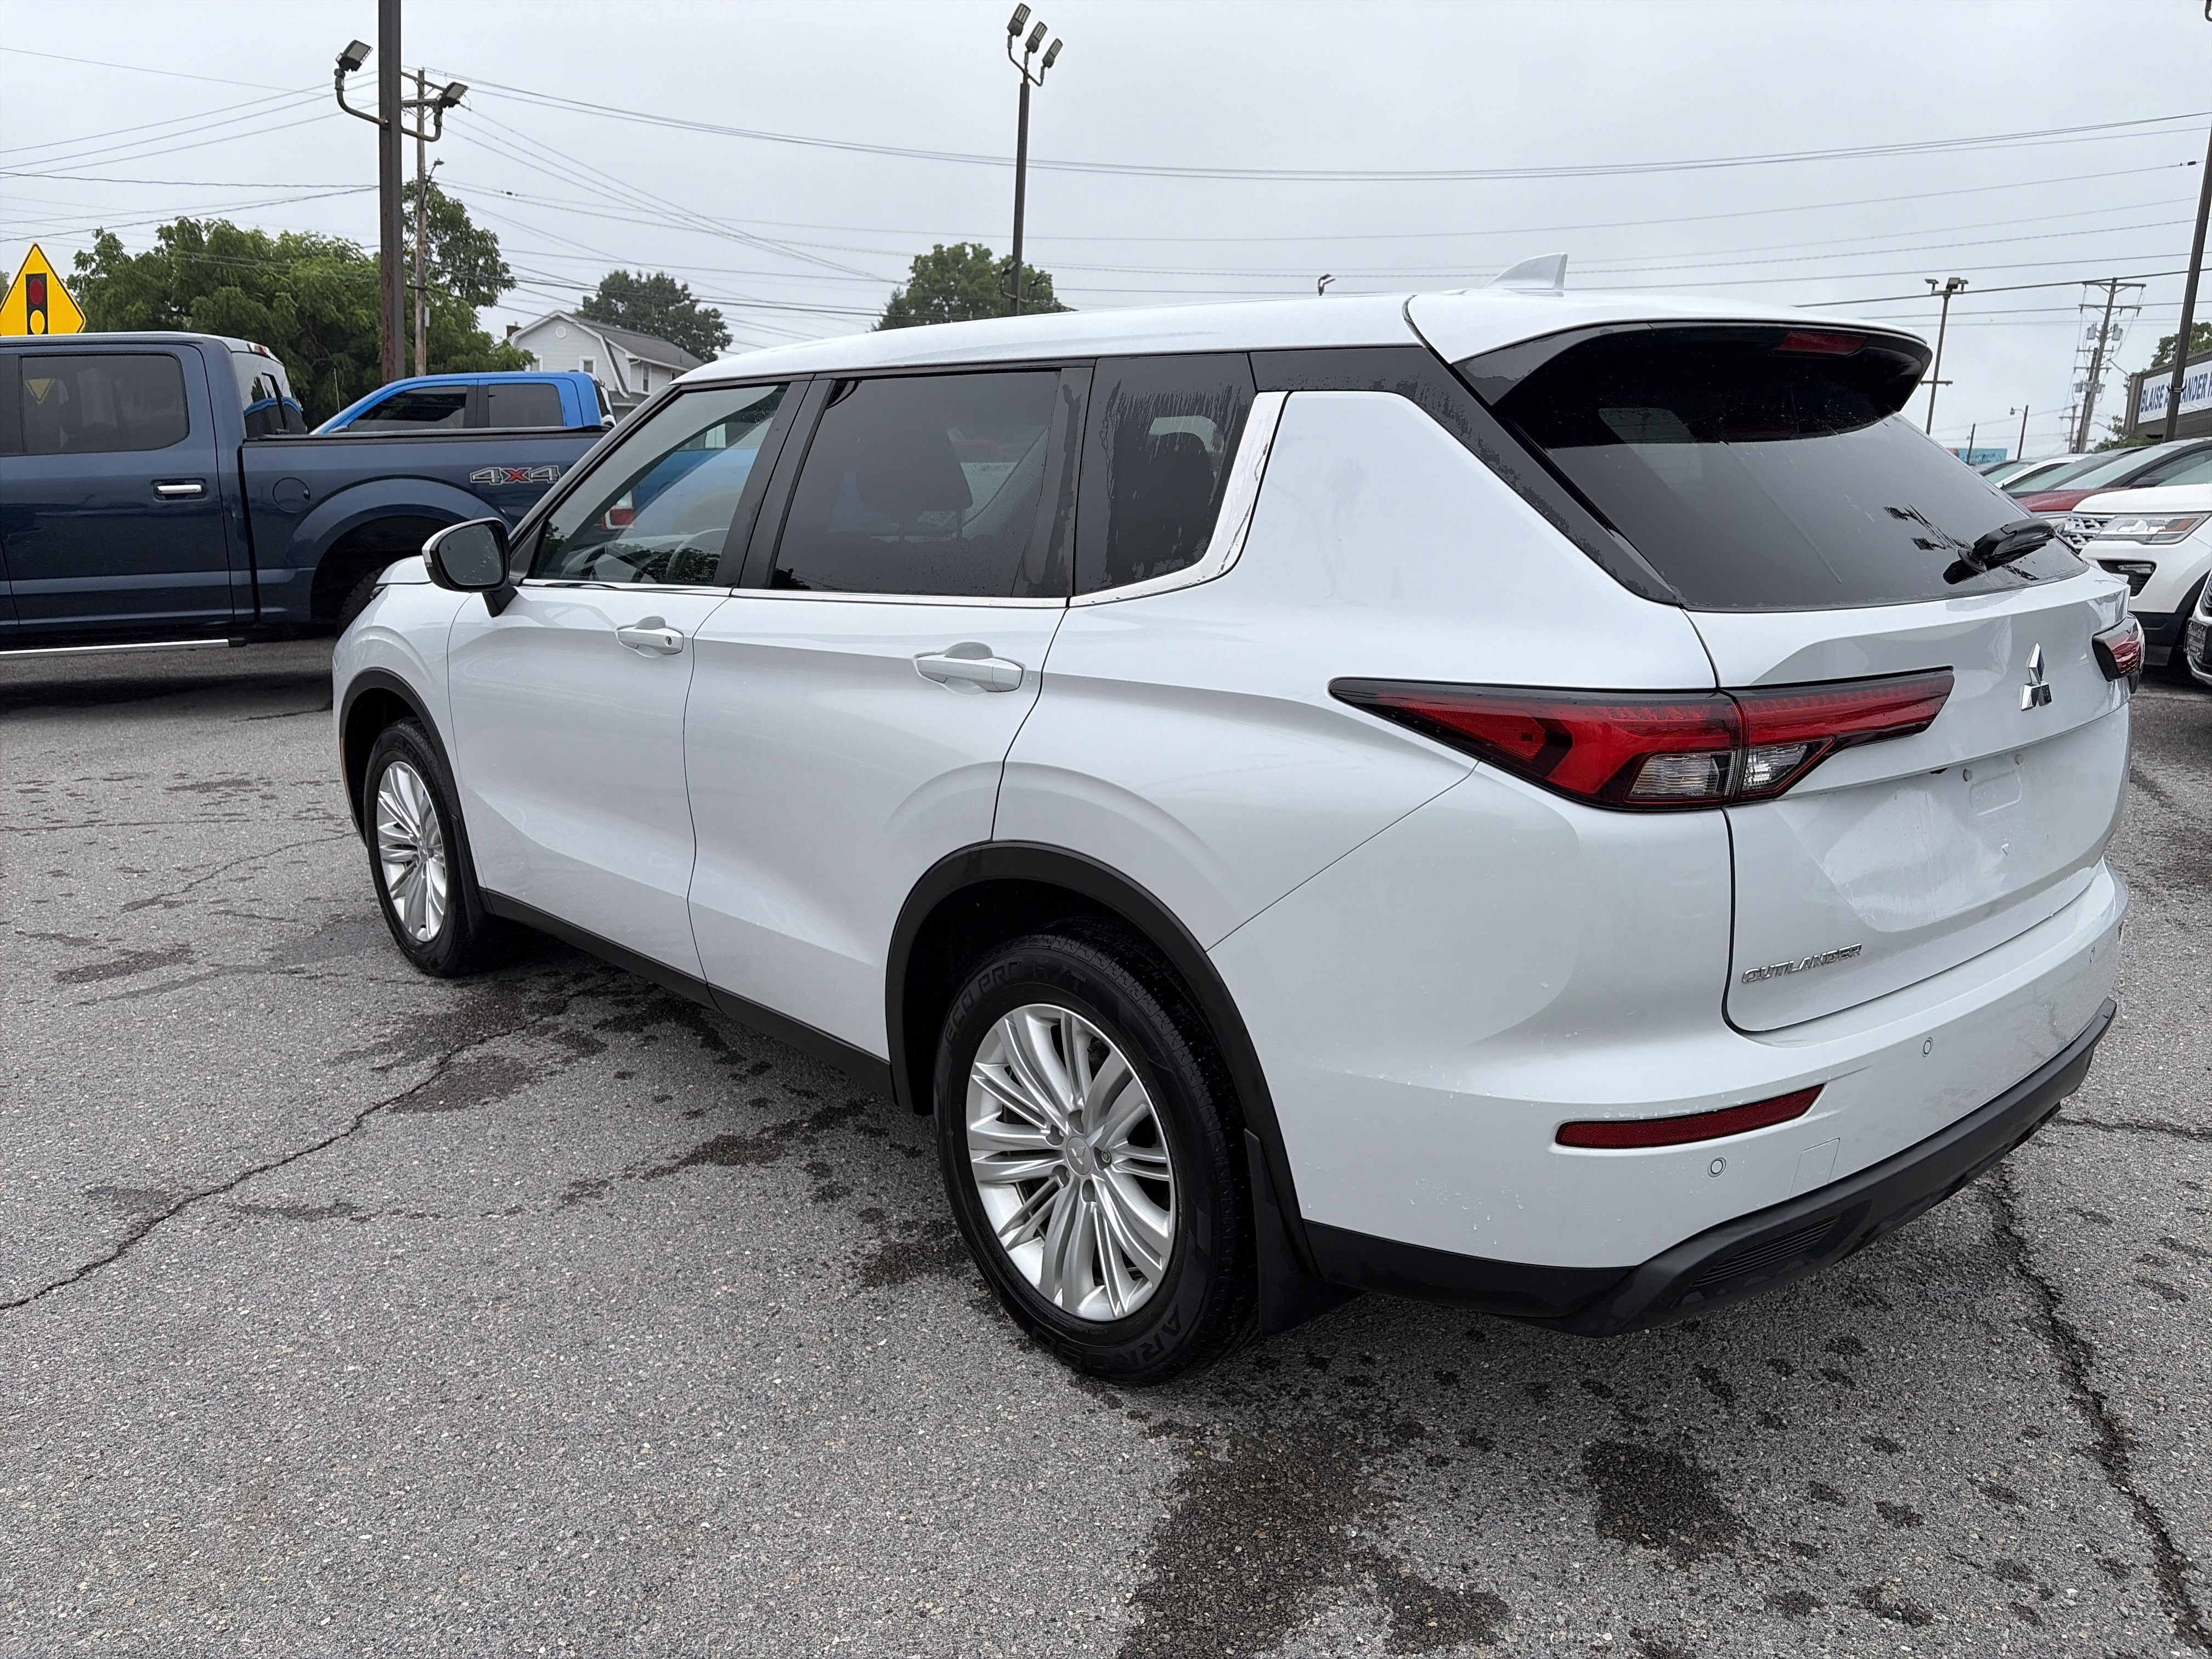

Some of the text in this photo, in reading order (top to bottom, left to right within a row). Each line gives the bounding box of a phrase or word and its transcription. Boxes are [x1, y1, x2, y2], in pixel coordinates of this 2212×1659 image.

[2140, 384, 2165, 413] BLAISE
[2164, 373, 2208, 408] AANDER
[1742, 943, 1863, 984] OUTLANDER
